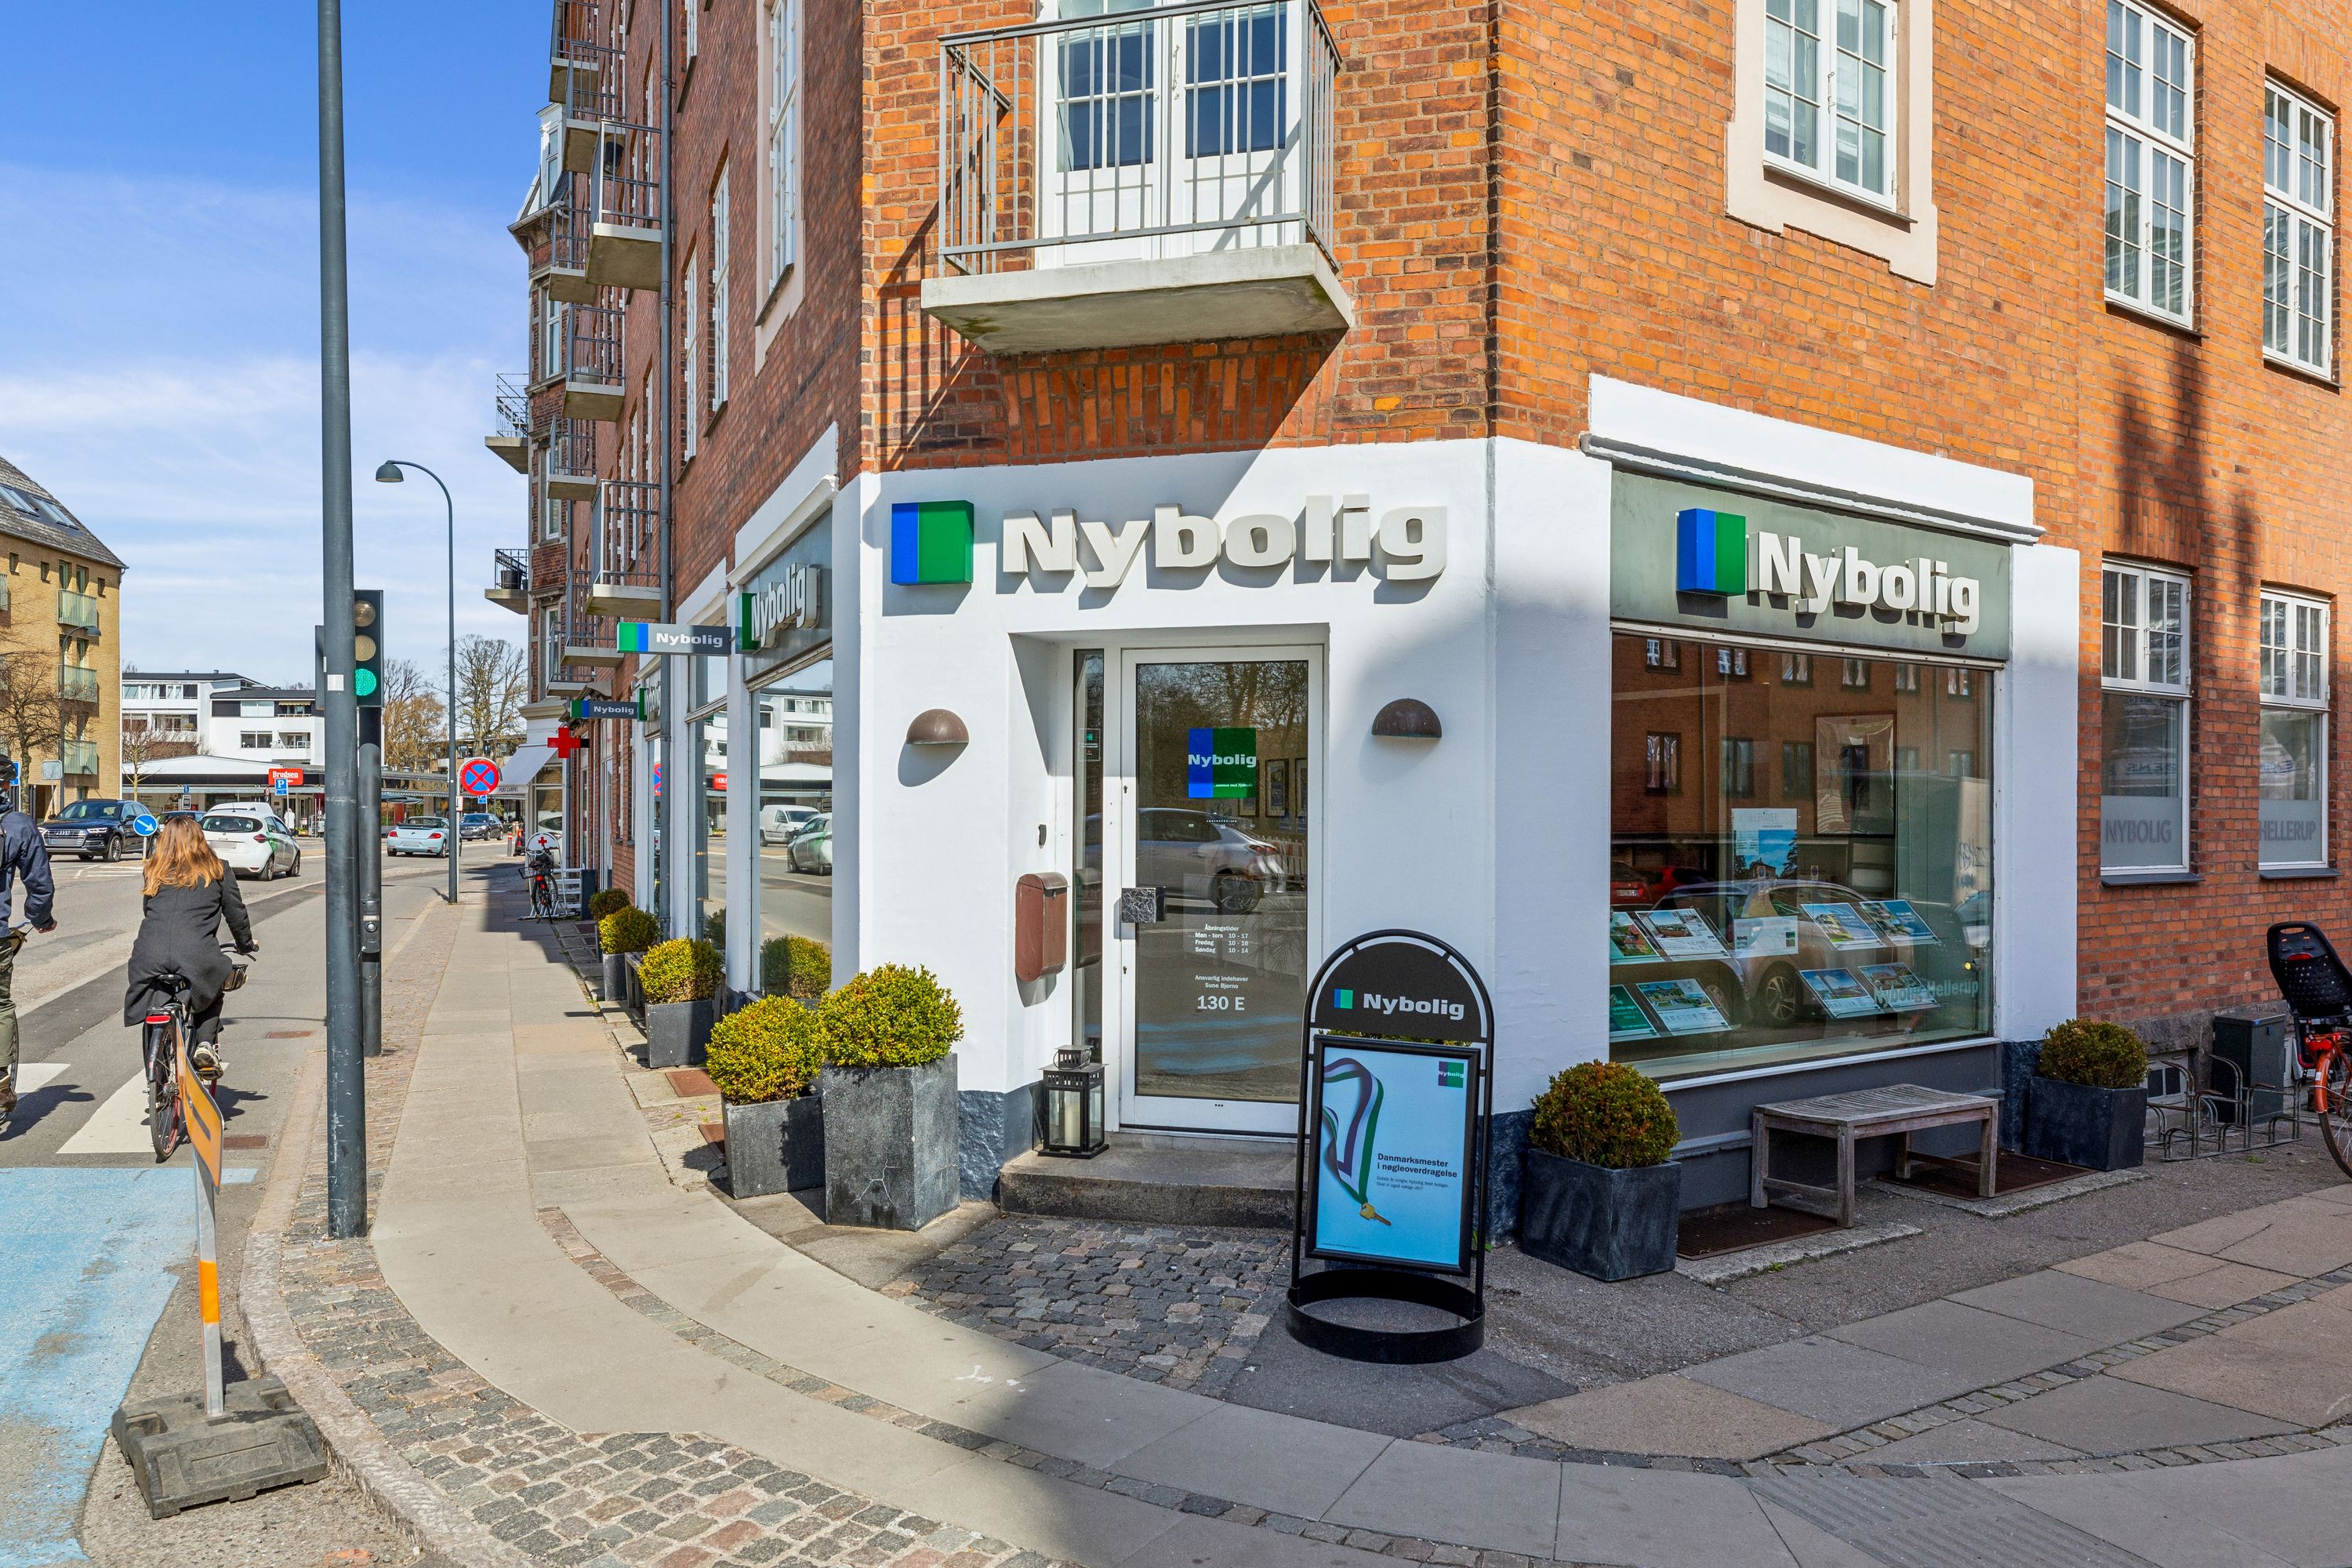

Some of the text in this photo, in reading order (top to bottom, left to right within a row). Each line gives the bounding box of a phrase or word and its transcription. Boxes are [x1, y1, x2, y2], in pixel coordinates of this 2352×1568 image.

[1003, 494, 1447, 588] Nybolig
[1748, 531, 1980, 635] Nybolig
[751, 563, 813, 648] Nybolig
[656, 633, 723, 648] Nybolig
[593, 706, 634, 715] Nybolig
[1188, 754, 1257, 768] Nybolig
[277, 779, 285, 789] P
[2106, 820, 2172, 843] NYBOLIG
[2259, 820, 2316, 841] HELLERUP
[1875, 980, 1979, 1008] Nybolig Hellerup
[1197, 995, 1245, 1011] 130 E
[1363, 993, 1465, 1020] Nybolig
[1438, 1070, 1465, 1079] Nybolig
[1377, 1152, 1449, 1167] Danmarksmester
[1382, 1163, 1457, 1178] nøgleoverdragelse
